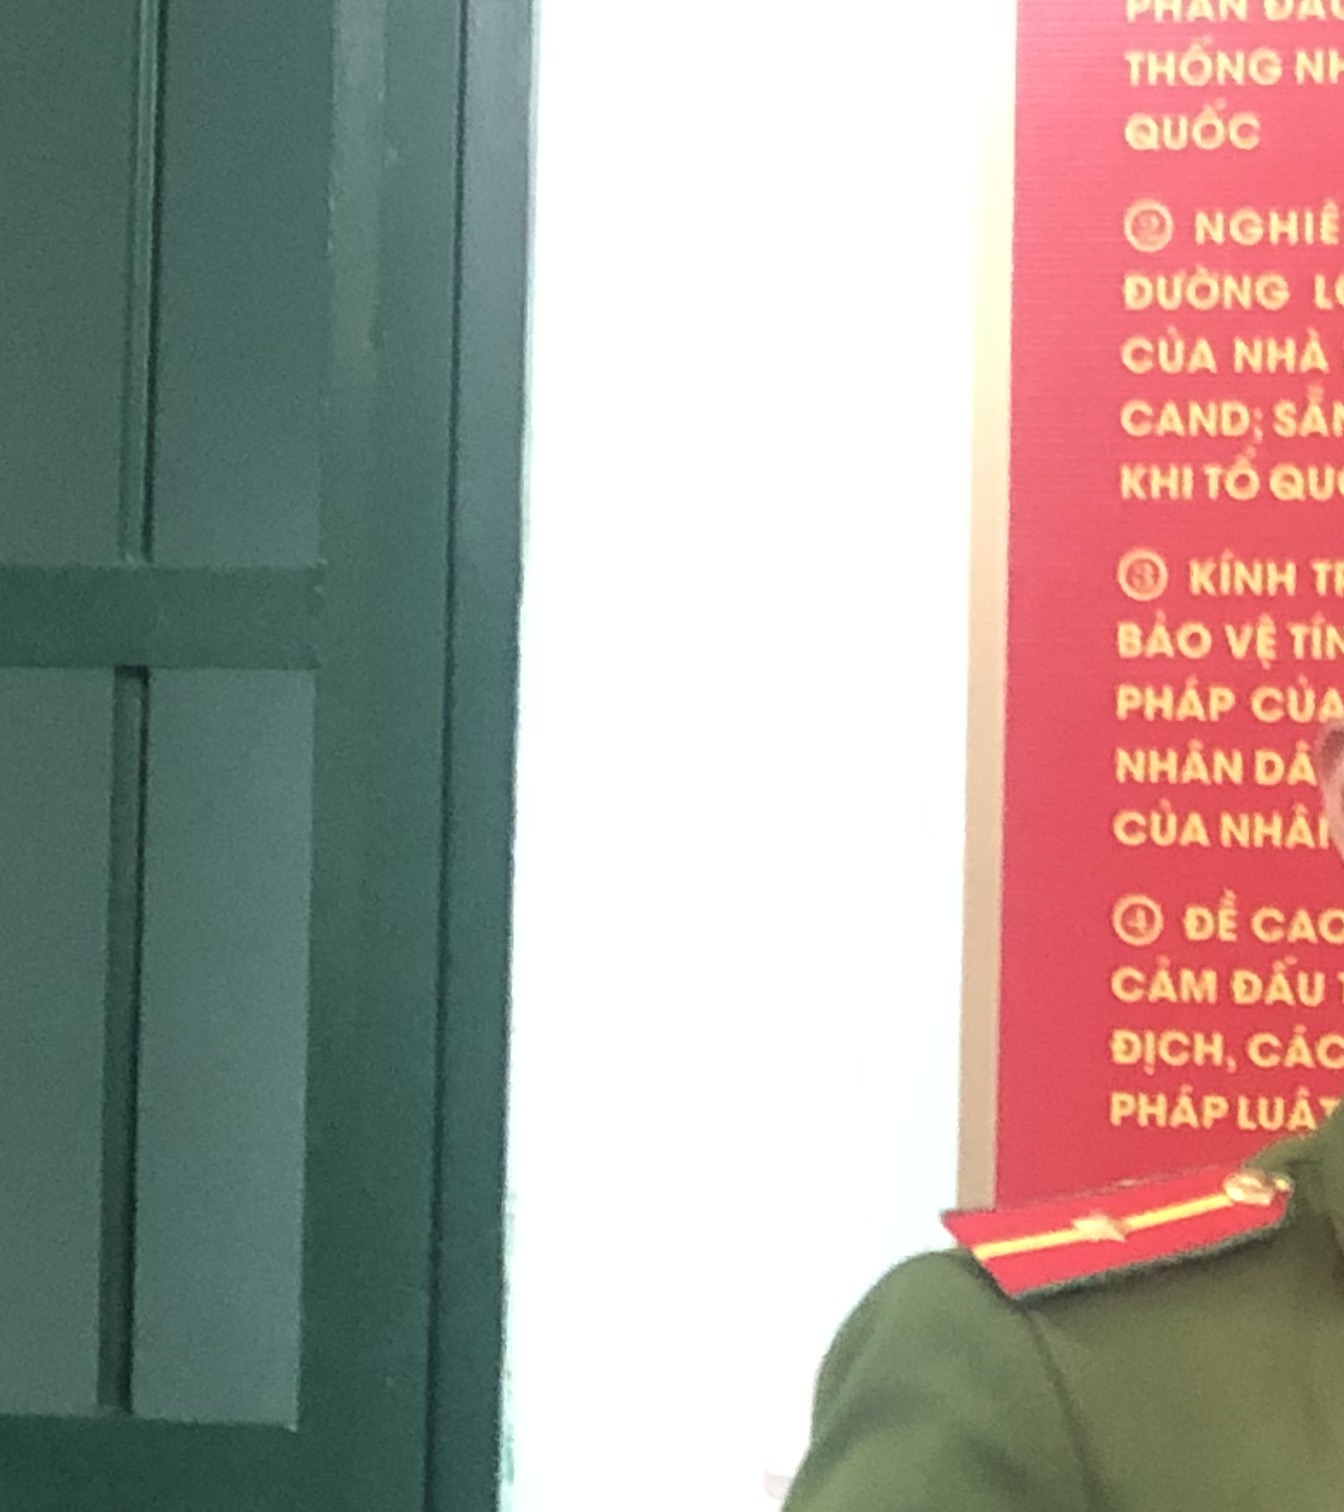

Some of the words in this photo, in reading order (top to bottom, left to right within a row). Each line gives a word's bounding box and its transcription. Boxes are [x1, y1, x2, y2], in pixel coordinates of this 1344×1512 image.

[1126, 36, 1282, 86] THỐNG
[1125, 99, 1260, 150] QUỐC
[1123, 265, 1290, 310] ĐƯỜNG
[1121, 326, 1216, 373] CỦA
[1234, 329, 1328, 372] NHÀ
[1121, 400, 1263, 442] CAND;
[1121, 464, 1194, 499] KHI
[1203, 446, 1260, 500] TỔ
[1190, 550, 1296, 596] KÍNH
[1117, 610, 1212, 659] BẢO
[1225, 614, 1276, 669] VỆ
[1116, 676, 1235, 721] PHÁP
[1251, 676, 1344, 724] CỦA
[1116, 740, 1243, 784] NHÂN
[1255, 741, 1316, 785] DÂ
[1113, 799, 1210, 846] CỦA
[1183, 887, 1237, 941] ĐỀ
[1111, 956, 1217, 1003] CẢM
[1231, 956, 1325, 1006] ĐẤU
[1110, 1029, 1236, 1075] ĐỊCH,
[1110, 1084, 1228, 1129] PHÁP
